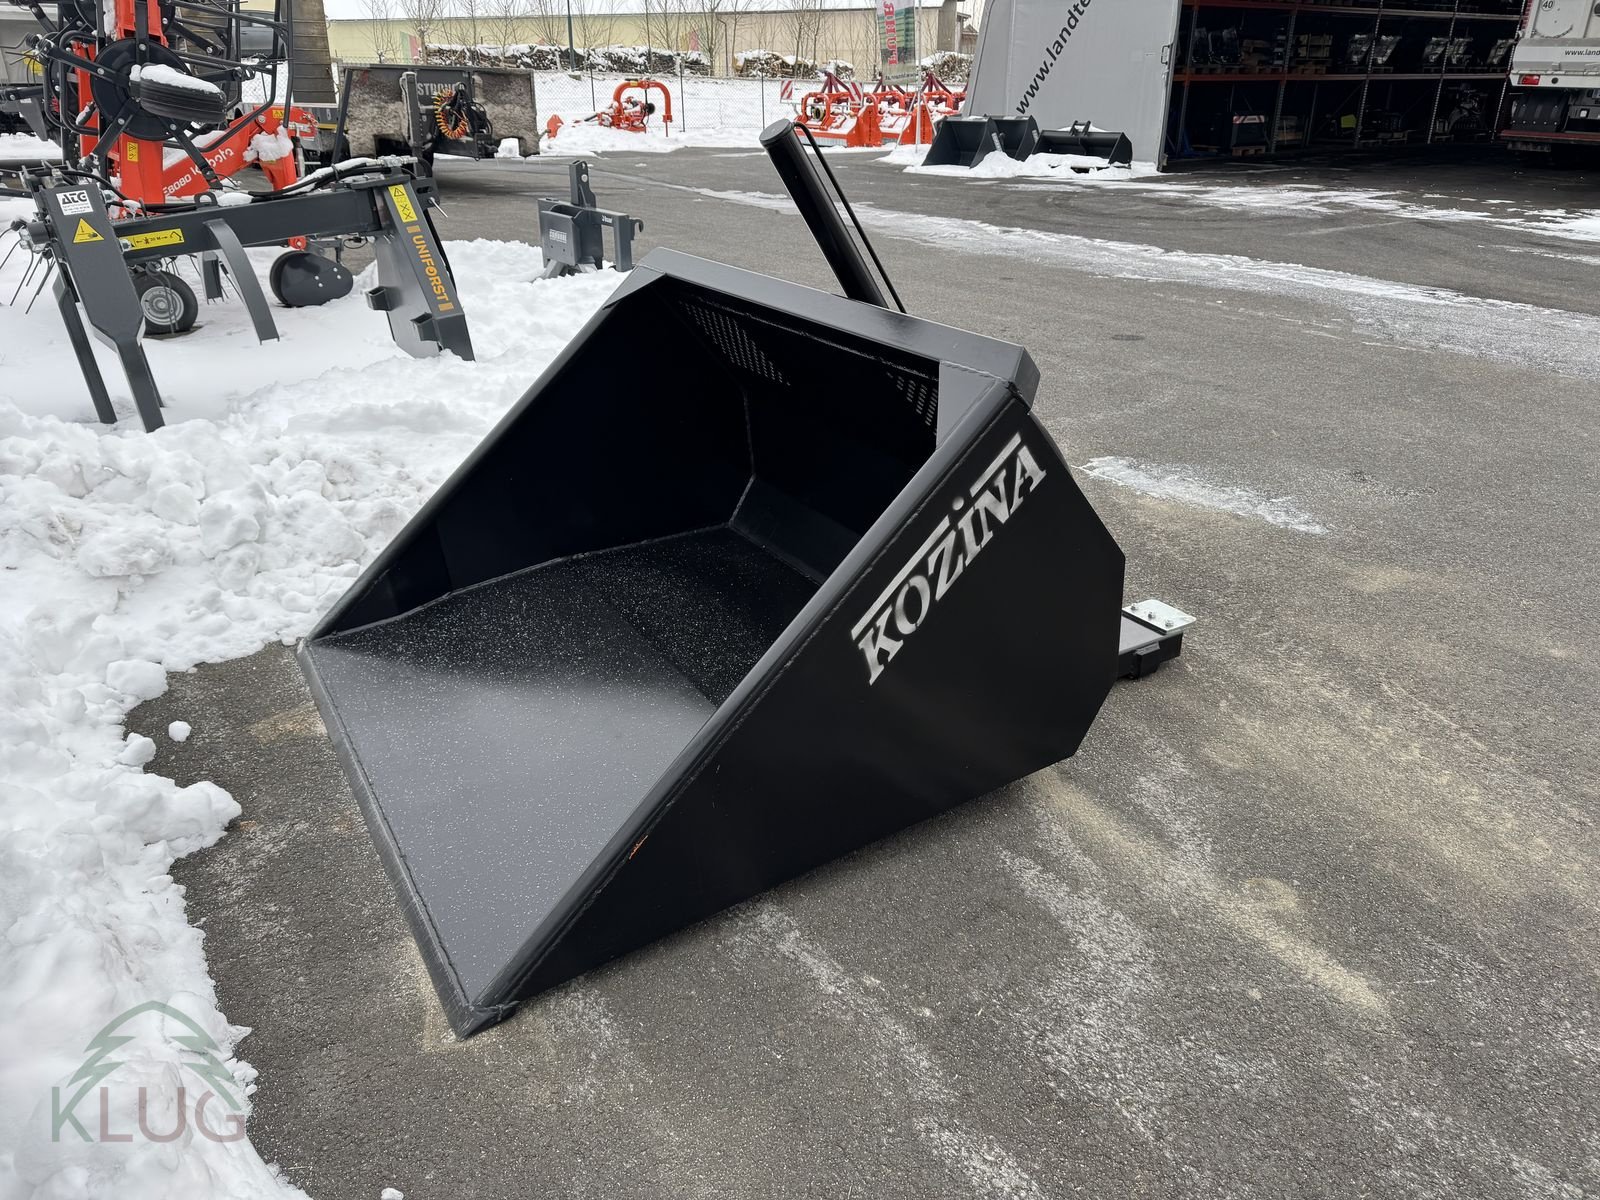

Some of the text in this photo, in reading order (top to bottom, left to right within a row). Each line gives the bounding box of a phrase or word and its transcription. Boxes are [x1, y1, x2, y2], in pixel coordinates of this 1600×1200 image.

[1542, 0, 1554, 9] 40
[190, 147, 234, 175] Kbota
[62, 192, 88, 205] ATG
[412, 235, 449, 301] UNIFORST
